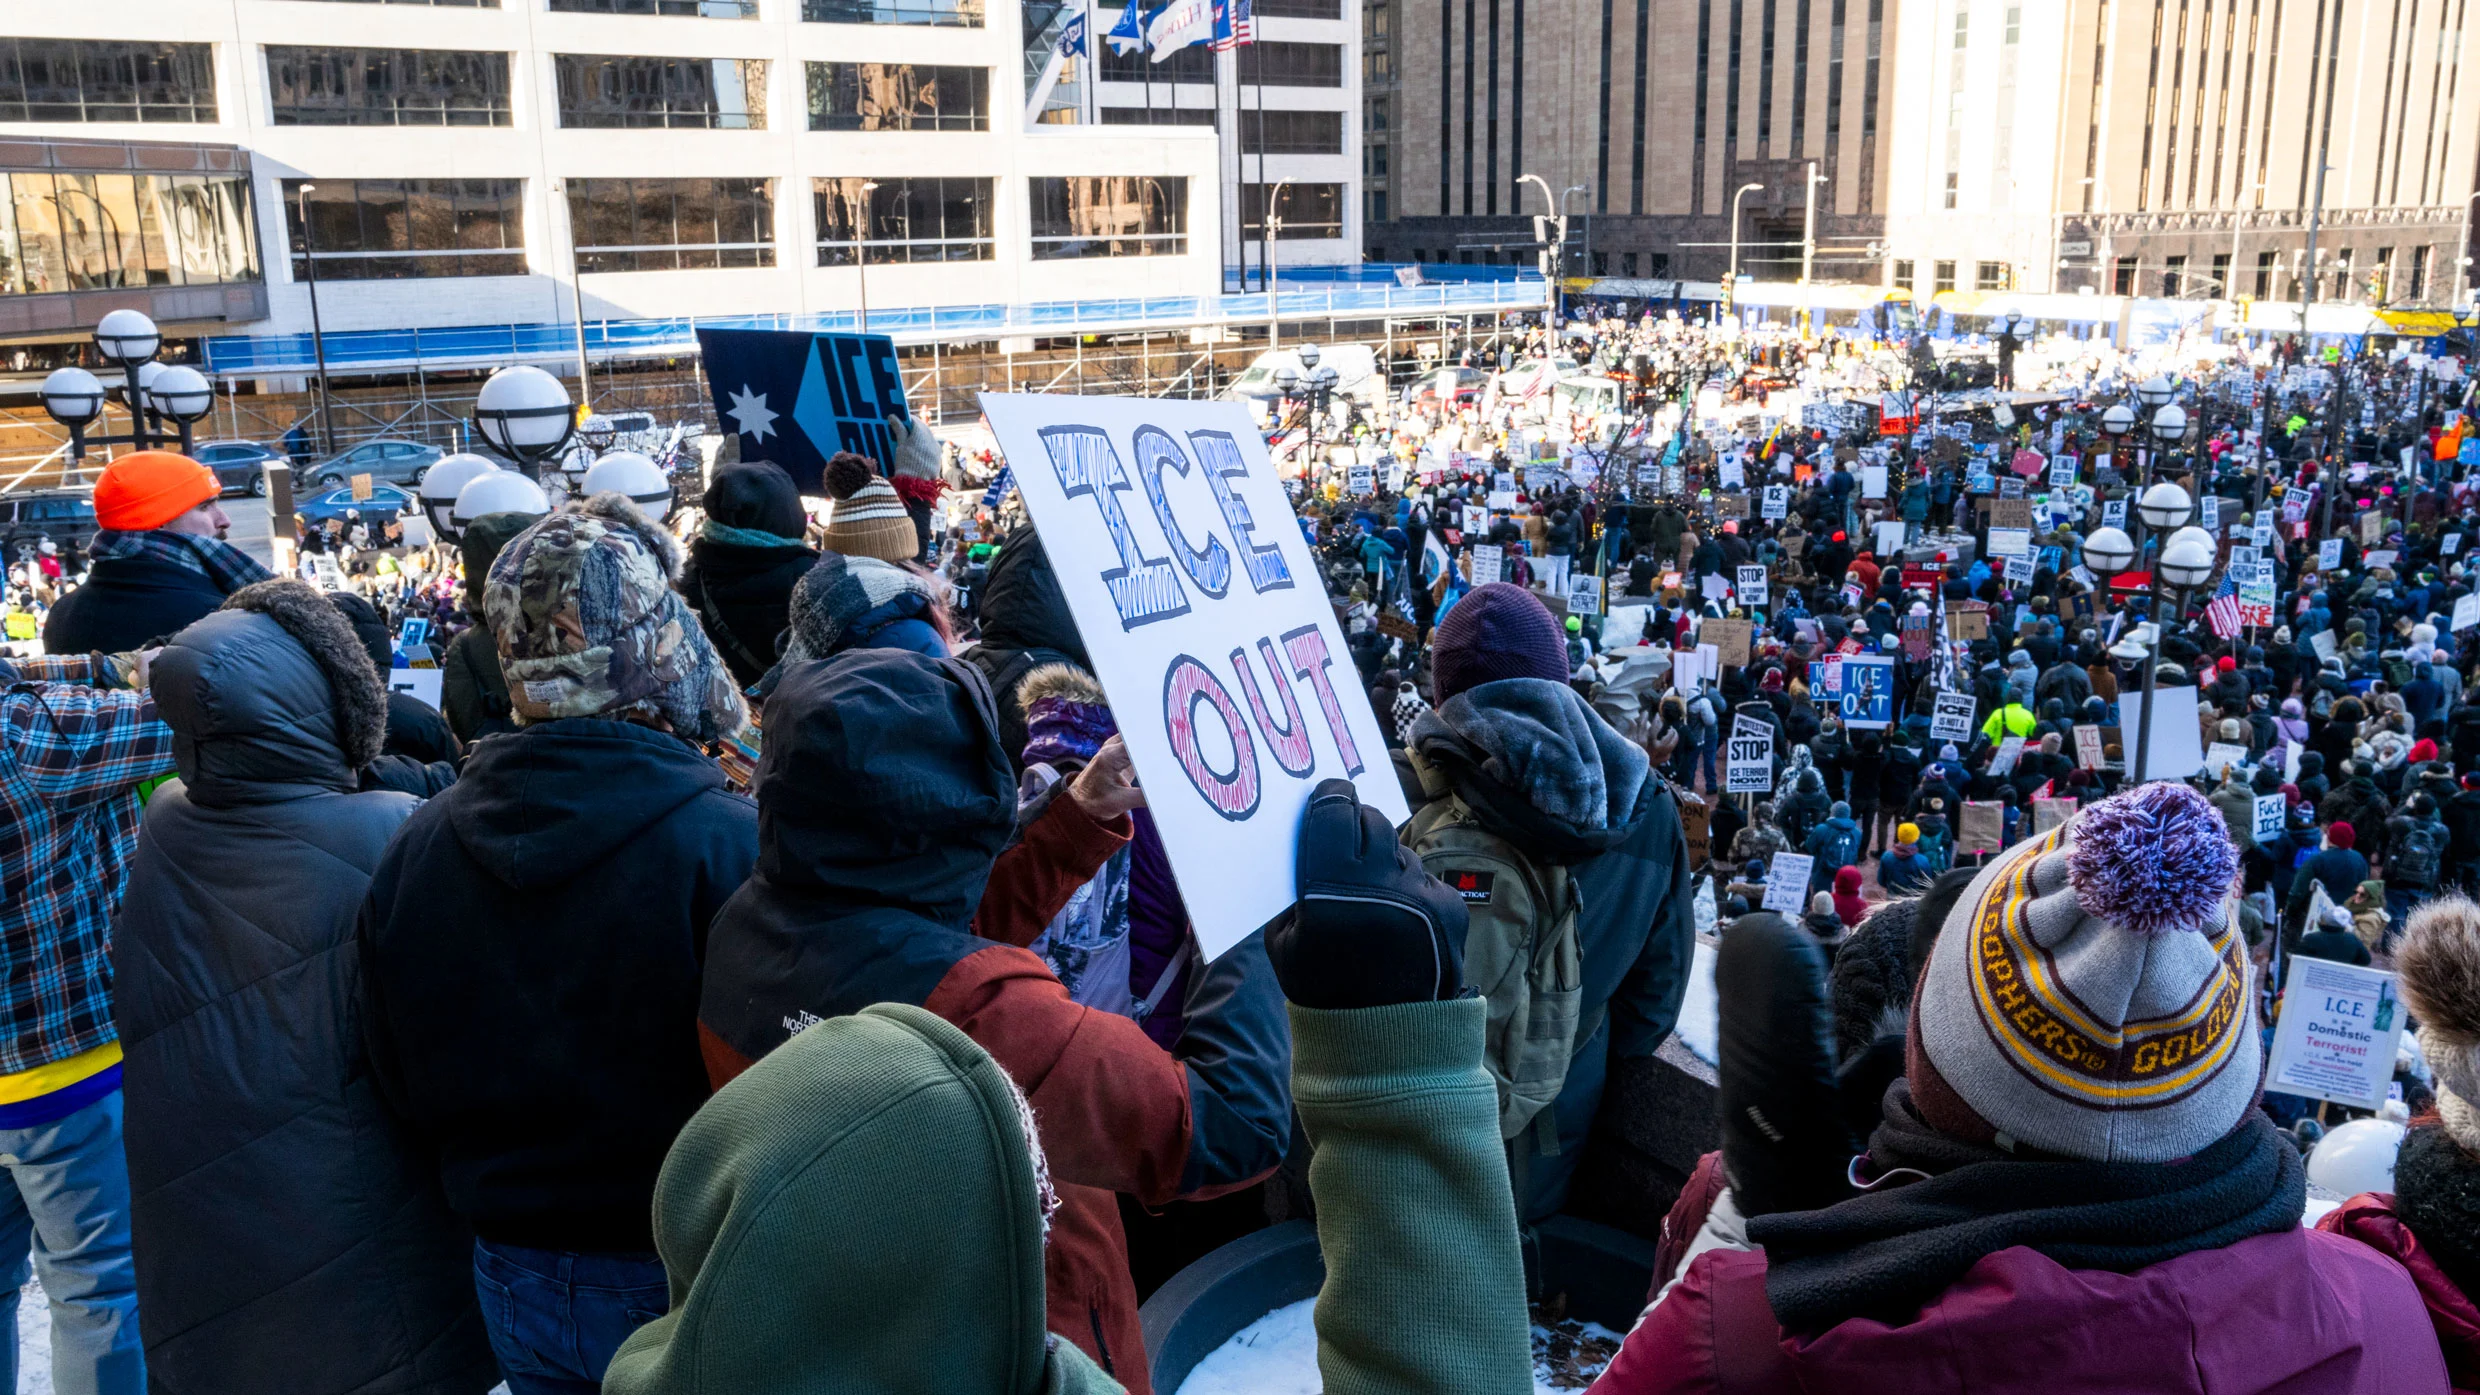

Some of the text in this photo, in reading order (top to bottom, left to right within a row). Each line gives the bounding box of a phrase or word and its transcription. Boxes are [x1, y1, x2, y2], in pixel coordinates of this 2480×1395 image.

[816, 337, 907, 421] ICE
[1769, 487, 1783, 501] ICE
[2289, 490, 2310, 503] STOP
[2109, 502, 2122, 514] ICE
[1037, 424, 1295, 632] ICE
[1922, 562, 1940, 571] ICE
[1740, 567, 1764, 583] STOP
[1903, 615, 1928, 629] ICE
[2240, 612, 2273, 627] ONE
[1852, 666, 1882, 690] ICE
[1938, 694, 1975, 707] PROTESTING
[1937, 704, 1972, 718] ICE
[1163, 624, 1365, 822] OUT
[1737, 717, 1773, 735] PROTESTING
[1939, 717, 1965, 728] IS NOT A
[2077, 729, 2099, 747] ICE
[1731, 740, 1770, 761] STOP
[1729, 767, 1769, 777] ICE TERROR
[1729, 777, 1769, 785] NOW!
[2258, 799, 2284, 816] FUCK
[2257, 817, 2284, 835] ICE
[2324, 997, 2365, 1018] I.C.E.
[2308, 1021, 2372, 1042] Domestic
[2306, 1036, 2368, 1056] Terrorist!
